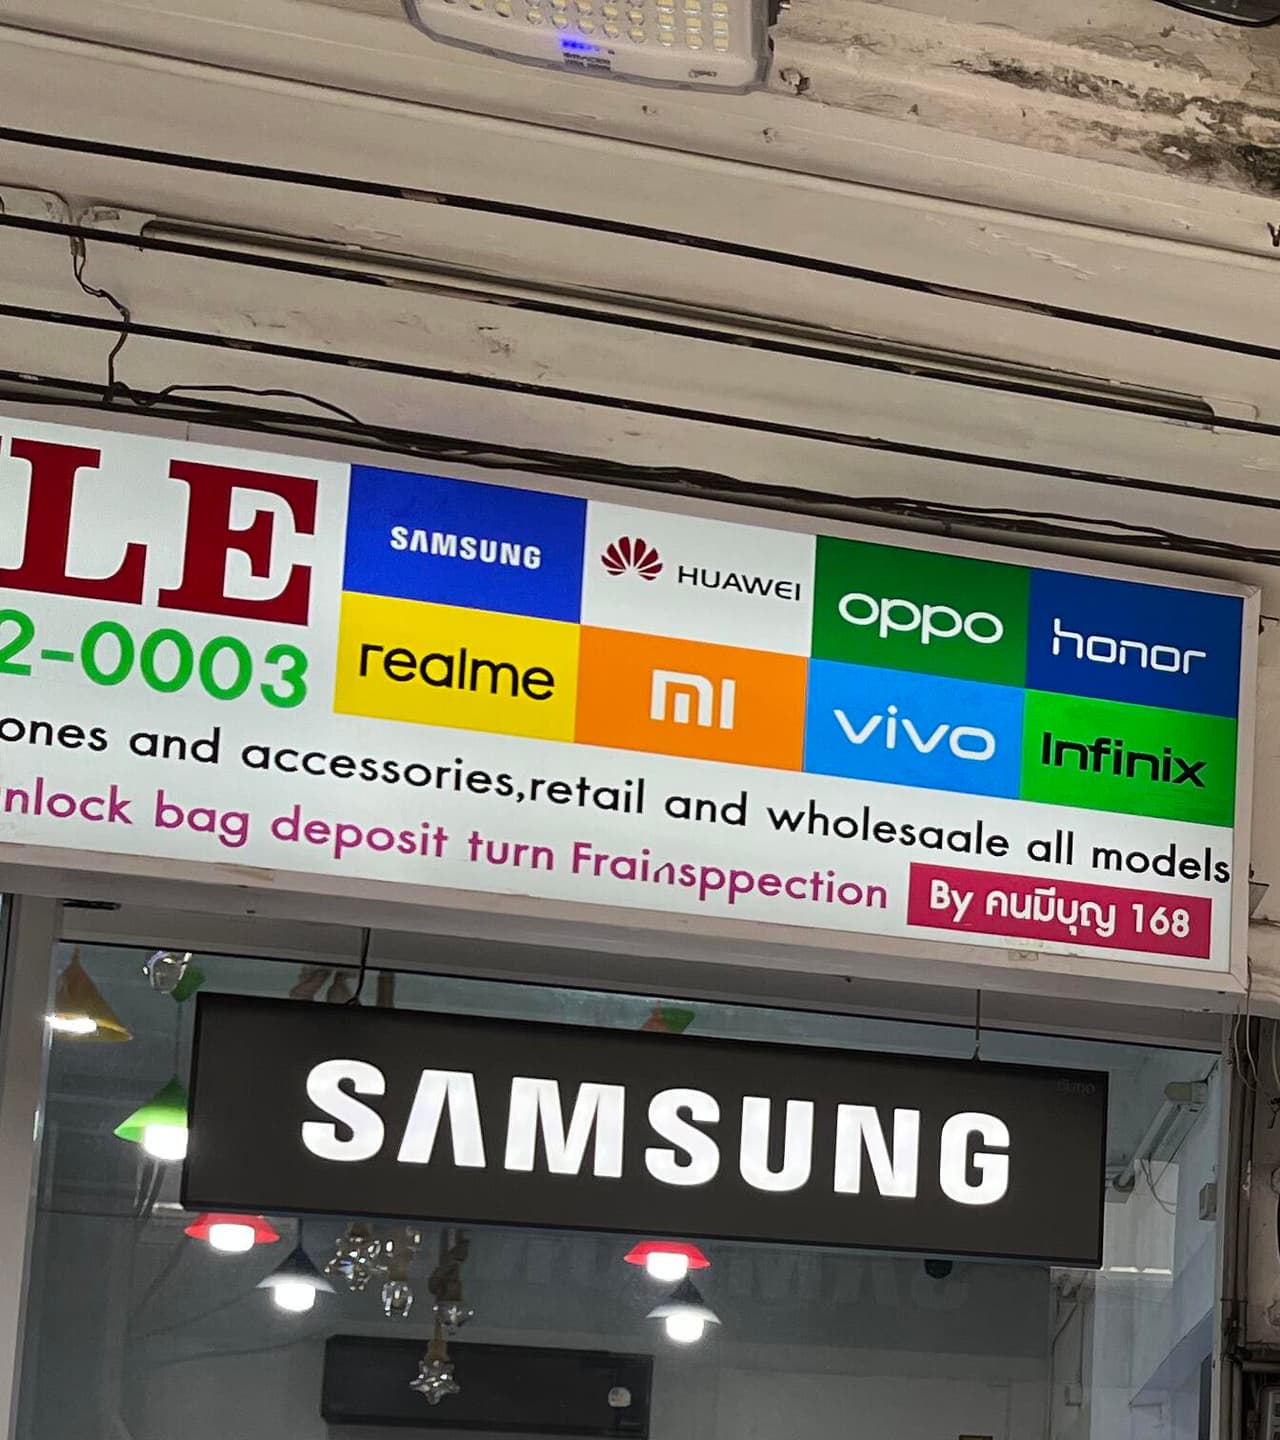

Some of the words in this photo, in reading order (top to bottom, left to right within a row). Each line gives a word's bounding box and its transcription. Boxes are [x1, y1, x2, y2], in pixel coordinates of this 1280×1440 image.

[0, 437, 318, 626] LE
[390, 525, 541, 570] SAMSUNG
[677, 564, 802, 602] HUAWEI
[838, 592, 1004, 645] oppo
[1052, 618, 1206, 675] honor
[357, 642, 556, 702] realme
[833, 705, 996, 762] vivo
[1041, 731, 1208, 789] Infinix
[128, 726, 221, 765] and
[664, 791, 748, 827] and
[1027, 831, 1074, 867] all
[1091, 843, 1231, 885] models
[155, 789, 250, 848] bag
[271, 805, 448, 858] deposit
[468, 834, 555, 871] turn
[929, 879, 974, 923] By
[985, 881, 1116, 938] คนมีบุญ
[1131, 903, 1191, 939] 168
[301, 1056, 1010, 1206] SAMSUNG
